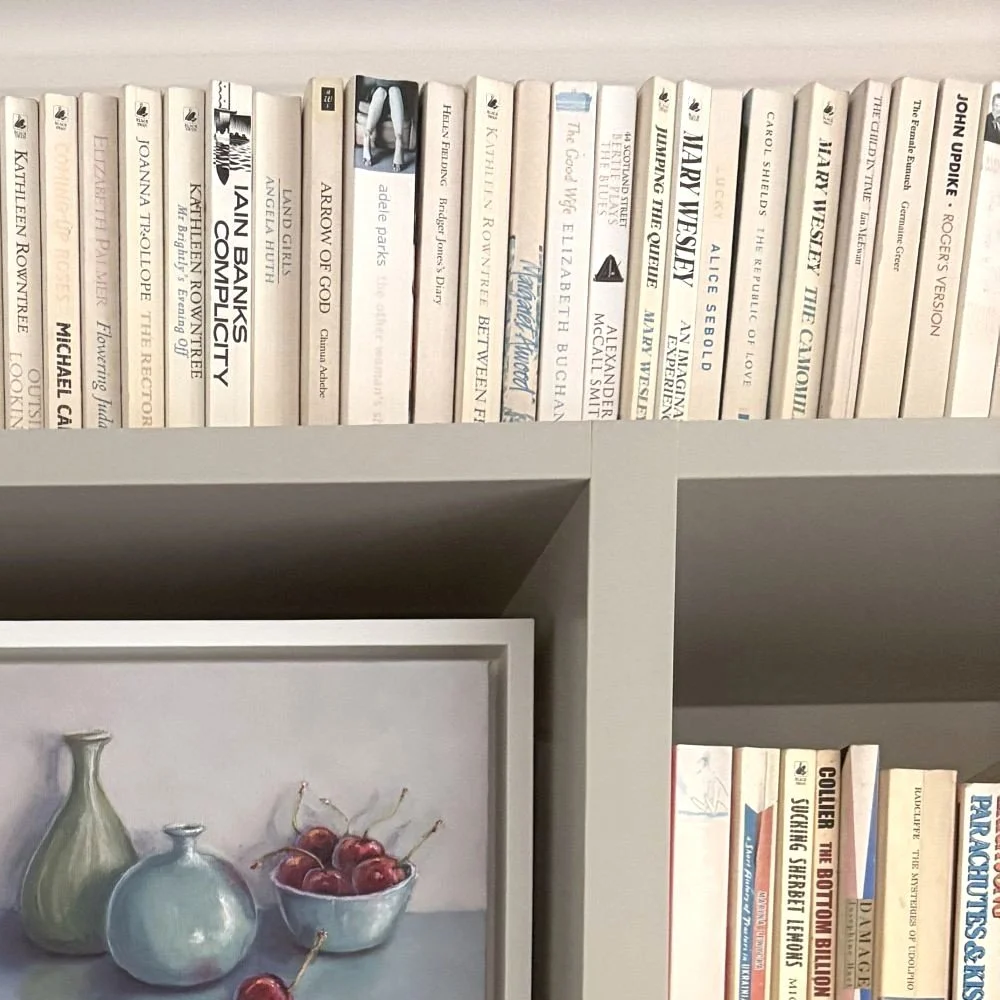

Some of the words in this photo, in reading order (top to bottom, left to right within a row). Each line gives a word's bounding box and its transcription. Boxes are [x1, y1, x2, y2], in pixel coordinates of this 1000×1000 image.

[763, 111, 774, 156] CAROL
[908, 119, 919, 154] Female
[912, 100, 921, 118] The
[952, 94, 969, 137] JOHN
[136, 136, 150, 206] JOANNA
[653, 124, 668, 195] JUMPING
[903, 156, 914, 191] Eunuch
[946, 142, 963, 196] UPDIKE
[233, 185, 248, 240] IAIN
[320, 182, 332, 246] ARROW
[651, 198, 663, 228] THE
[758, 161, 770, 216] SHIELDS
[139, 212, 151, 301] TROLLOPE
[320, 249, 332, 272] OF
[646, 232, 661, 288] QUEUE
[707, 244, 720, 294] ALICE
[938, 214, 954, 271] ROGER'S
[213, 220, 229, 387] COMPLICITY
[233, 246, 248, 343] BANKS
[319, 275, 331, 314] GOD
[511, 259, 541, 331] Margaret
[929, 276, 946, 337] VERSION
[509, 333, 536, 395] Atwood
[701, 304, 716, 371] SEBOLD
[788, 798, 810, 852] SUCKING
[817, 767, 836, 829] COLLIER
[819, 842, 833, 864] THE
[788, 858, 807, 912] SHERBET
[815, 868, 834, 934] BOTTOM
[785, 920, 805, 967] LEMONS
[813, 939, 833, 997] BILLION
